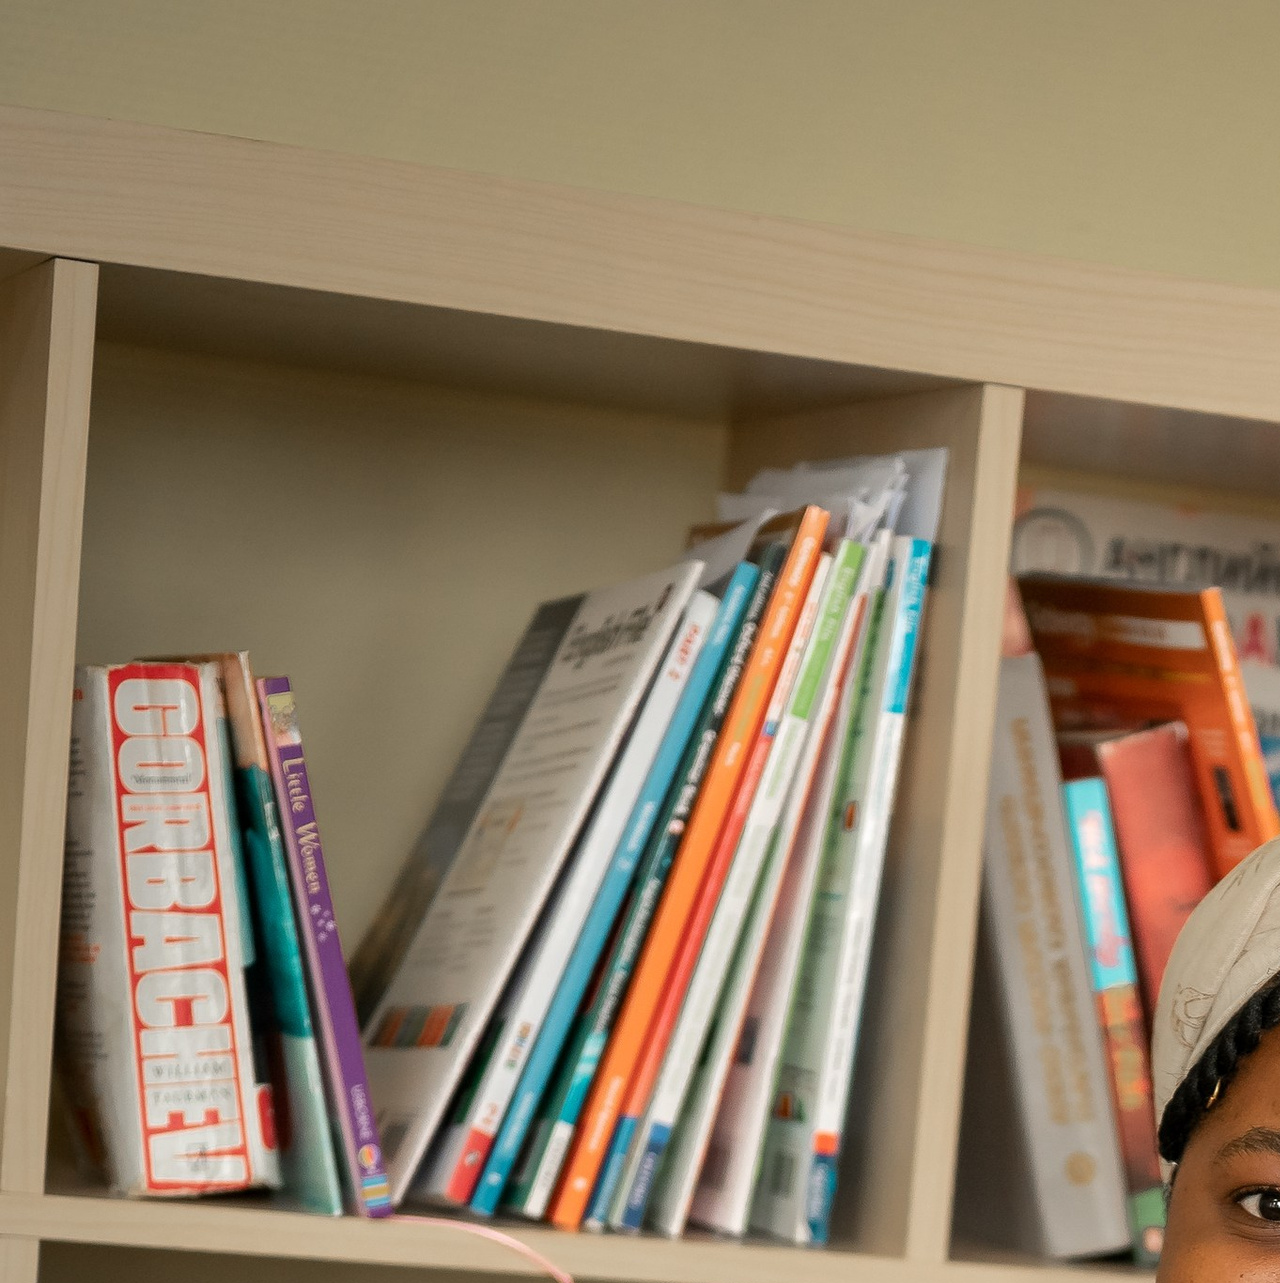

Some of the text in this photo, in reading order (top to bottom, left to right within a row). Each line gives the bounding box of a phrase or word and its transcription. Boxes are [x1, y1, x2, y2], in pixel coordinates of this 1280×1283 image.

[281, 756, 322, 896] Little Women
[113, 677, 250, 1184] GORBACHEV
[350, 1083, 373, 1140] USBORNE
